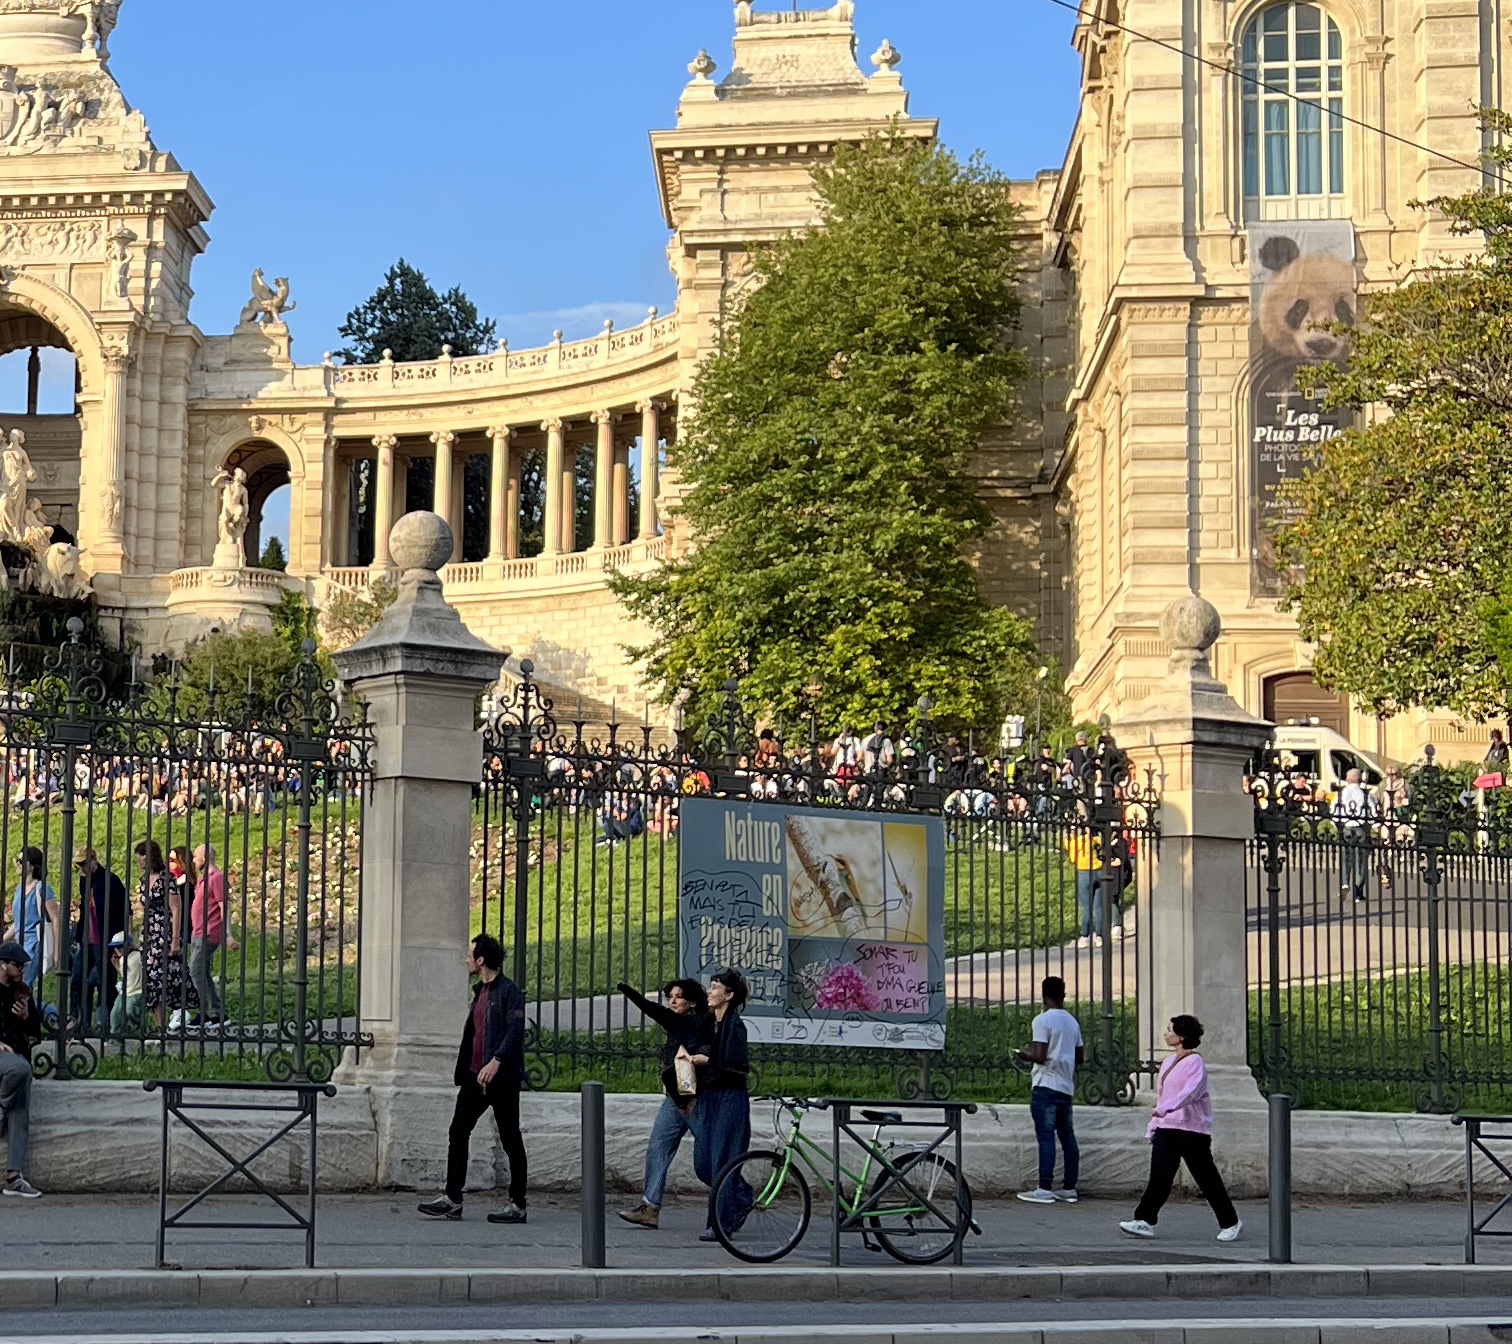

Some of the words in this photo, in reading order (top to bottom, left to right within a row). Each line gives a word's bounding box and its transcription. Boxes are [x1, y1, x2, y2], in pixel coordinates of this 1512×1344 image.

[1285, 409, 1319, 426] Les
[1253, 425, 1295, 443] Plus
[1297, 424, 1347, 442] Belle
[724, 810, 781, 865] Nature
[689, 896, 725, 911] MAIS
[762, 873, 782, 917] en
[700, 915, 783, 970] Provence
[903, 950, 918, 965] TU
